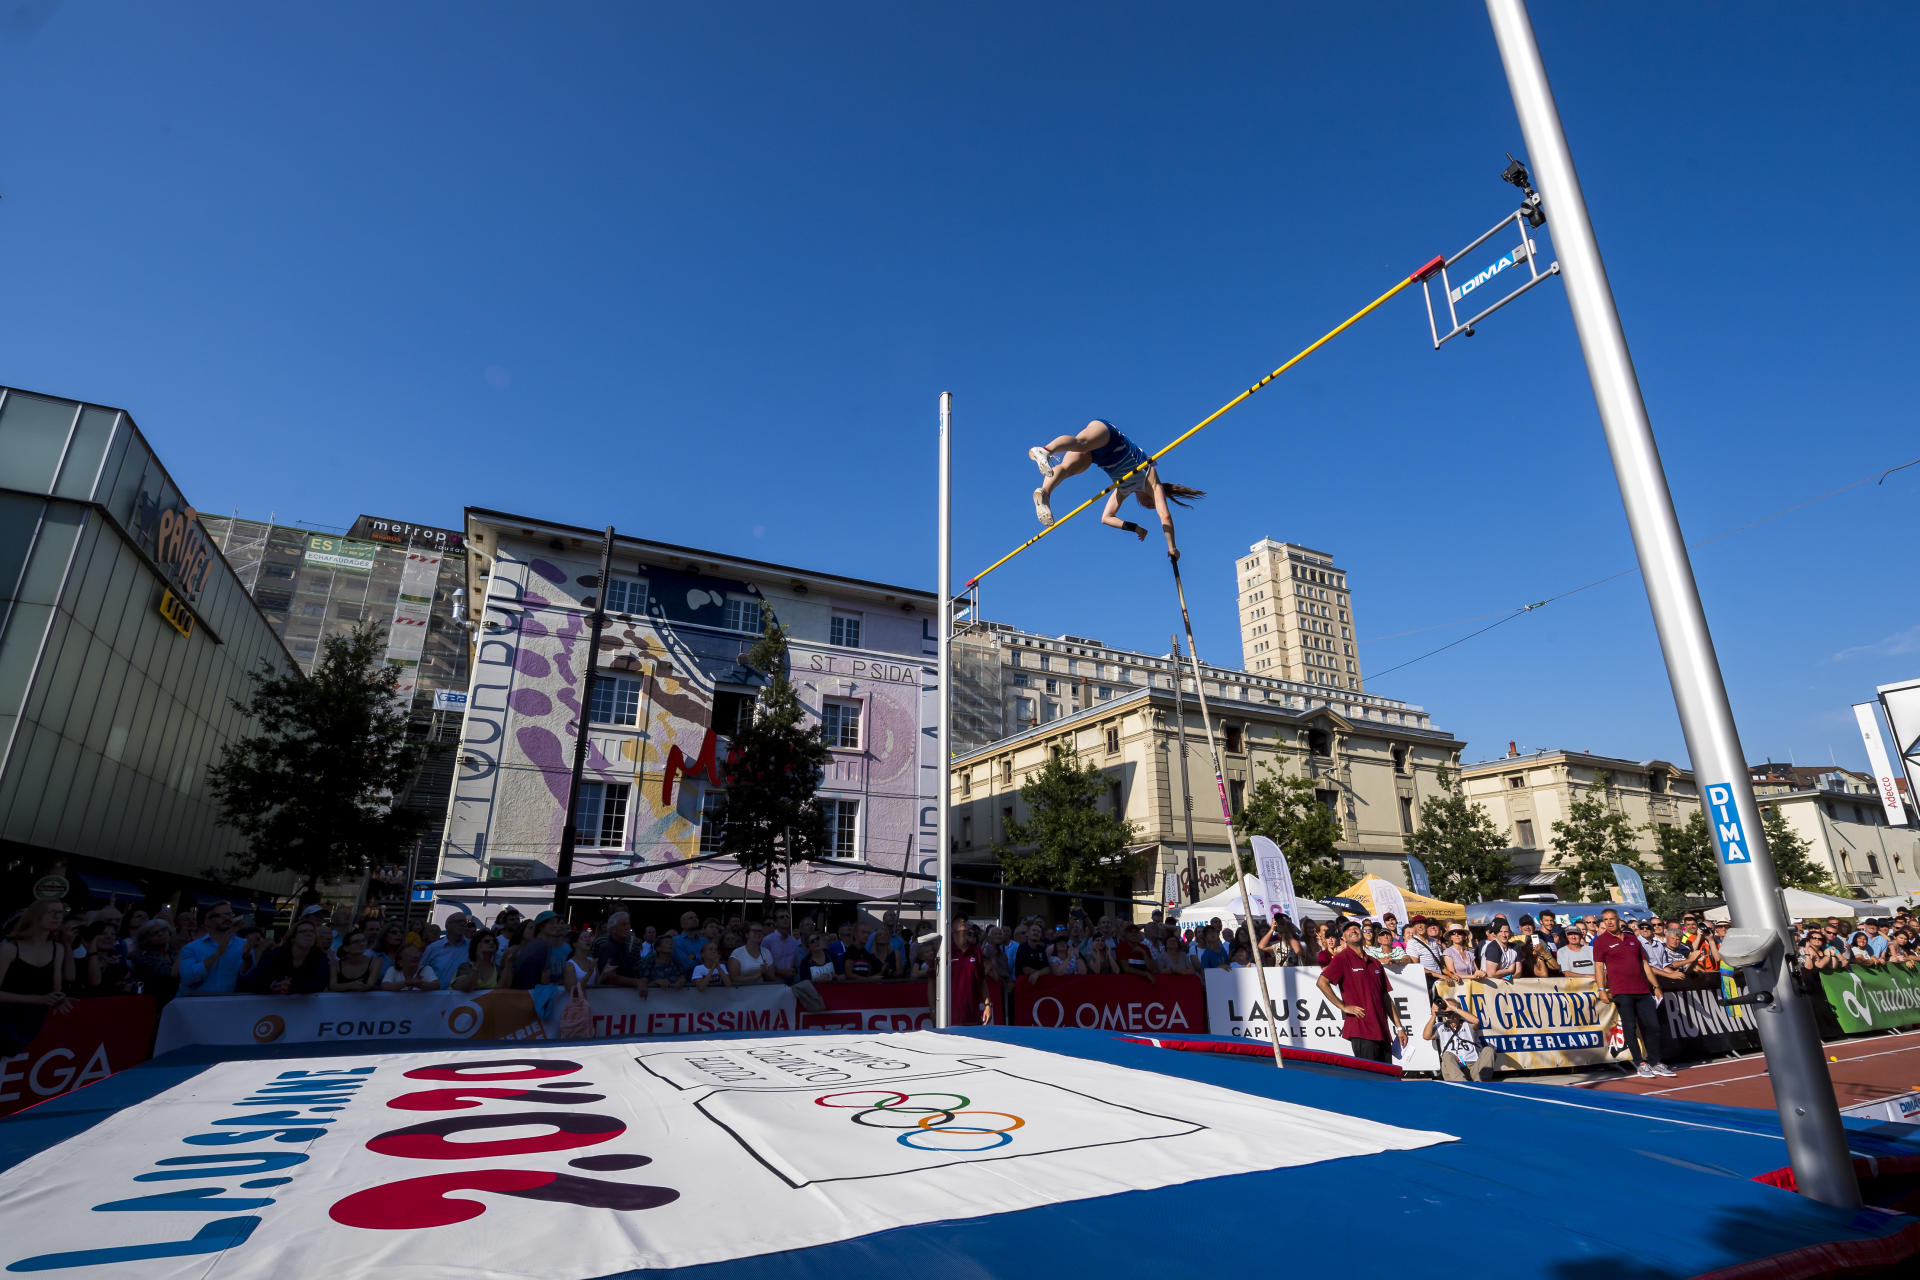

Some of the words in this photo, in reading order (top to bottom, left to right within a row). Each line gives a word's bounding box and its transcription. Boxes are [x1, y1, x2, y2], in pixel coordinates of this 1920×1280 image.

[1461, 256, 1512, 296] DIMA
[309, 538, 333, 552] ES
[434, 543, 466, 554] lausan
[1881, 776, 1897, 809] Adecco
[1709, 786, 1746, 862] DIMA
[1176, 920, 1208, 929] AUSANNE
[1075, 1001, 1189, 1031] OMEGA
[1228, 997, 1411, 1022] LAUSAE
[1457, 993, 1492, 1030] LE
[1494, 985, 1600, 1030] GRUYÈRE
[317, 1019, 413, 1038] FONDS
[593, 1008, 790, 1037] THLETISSIMA
[1484, 1033, 1600, 1051] WITZERLAND
